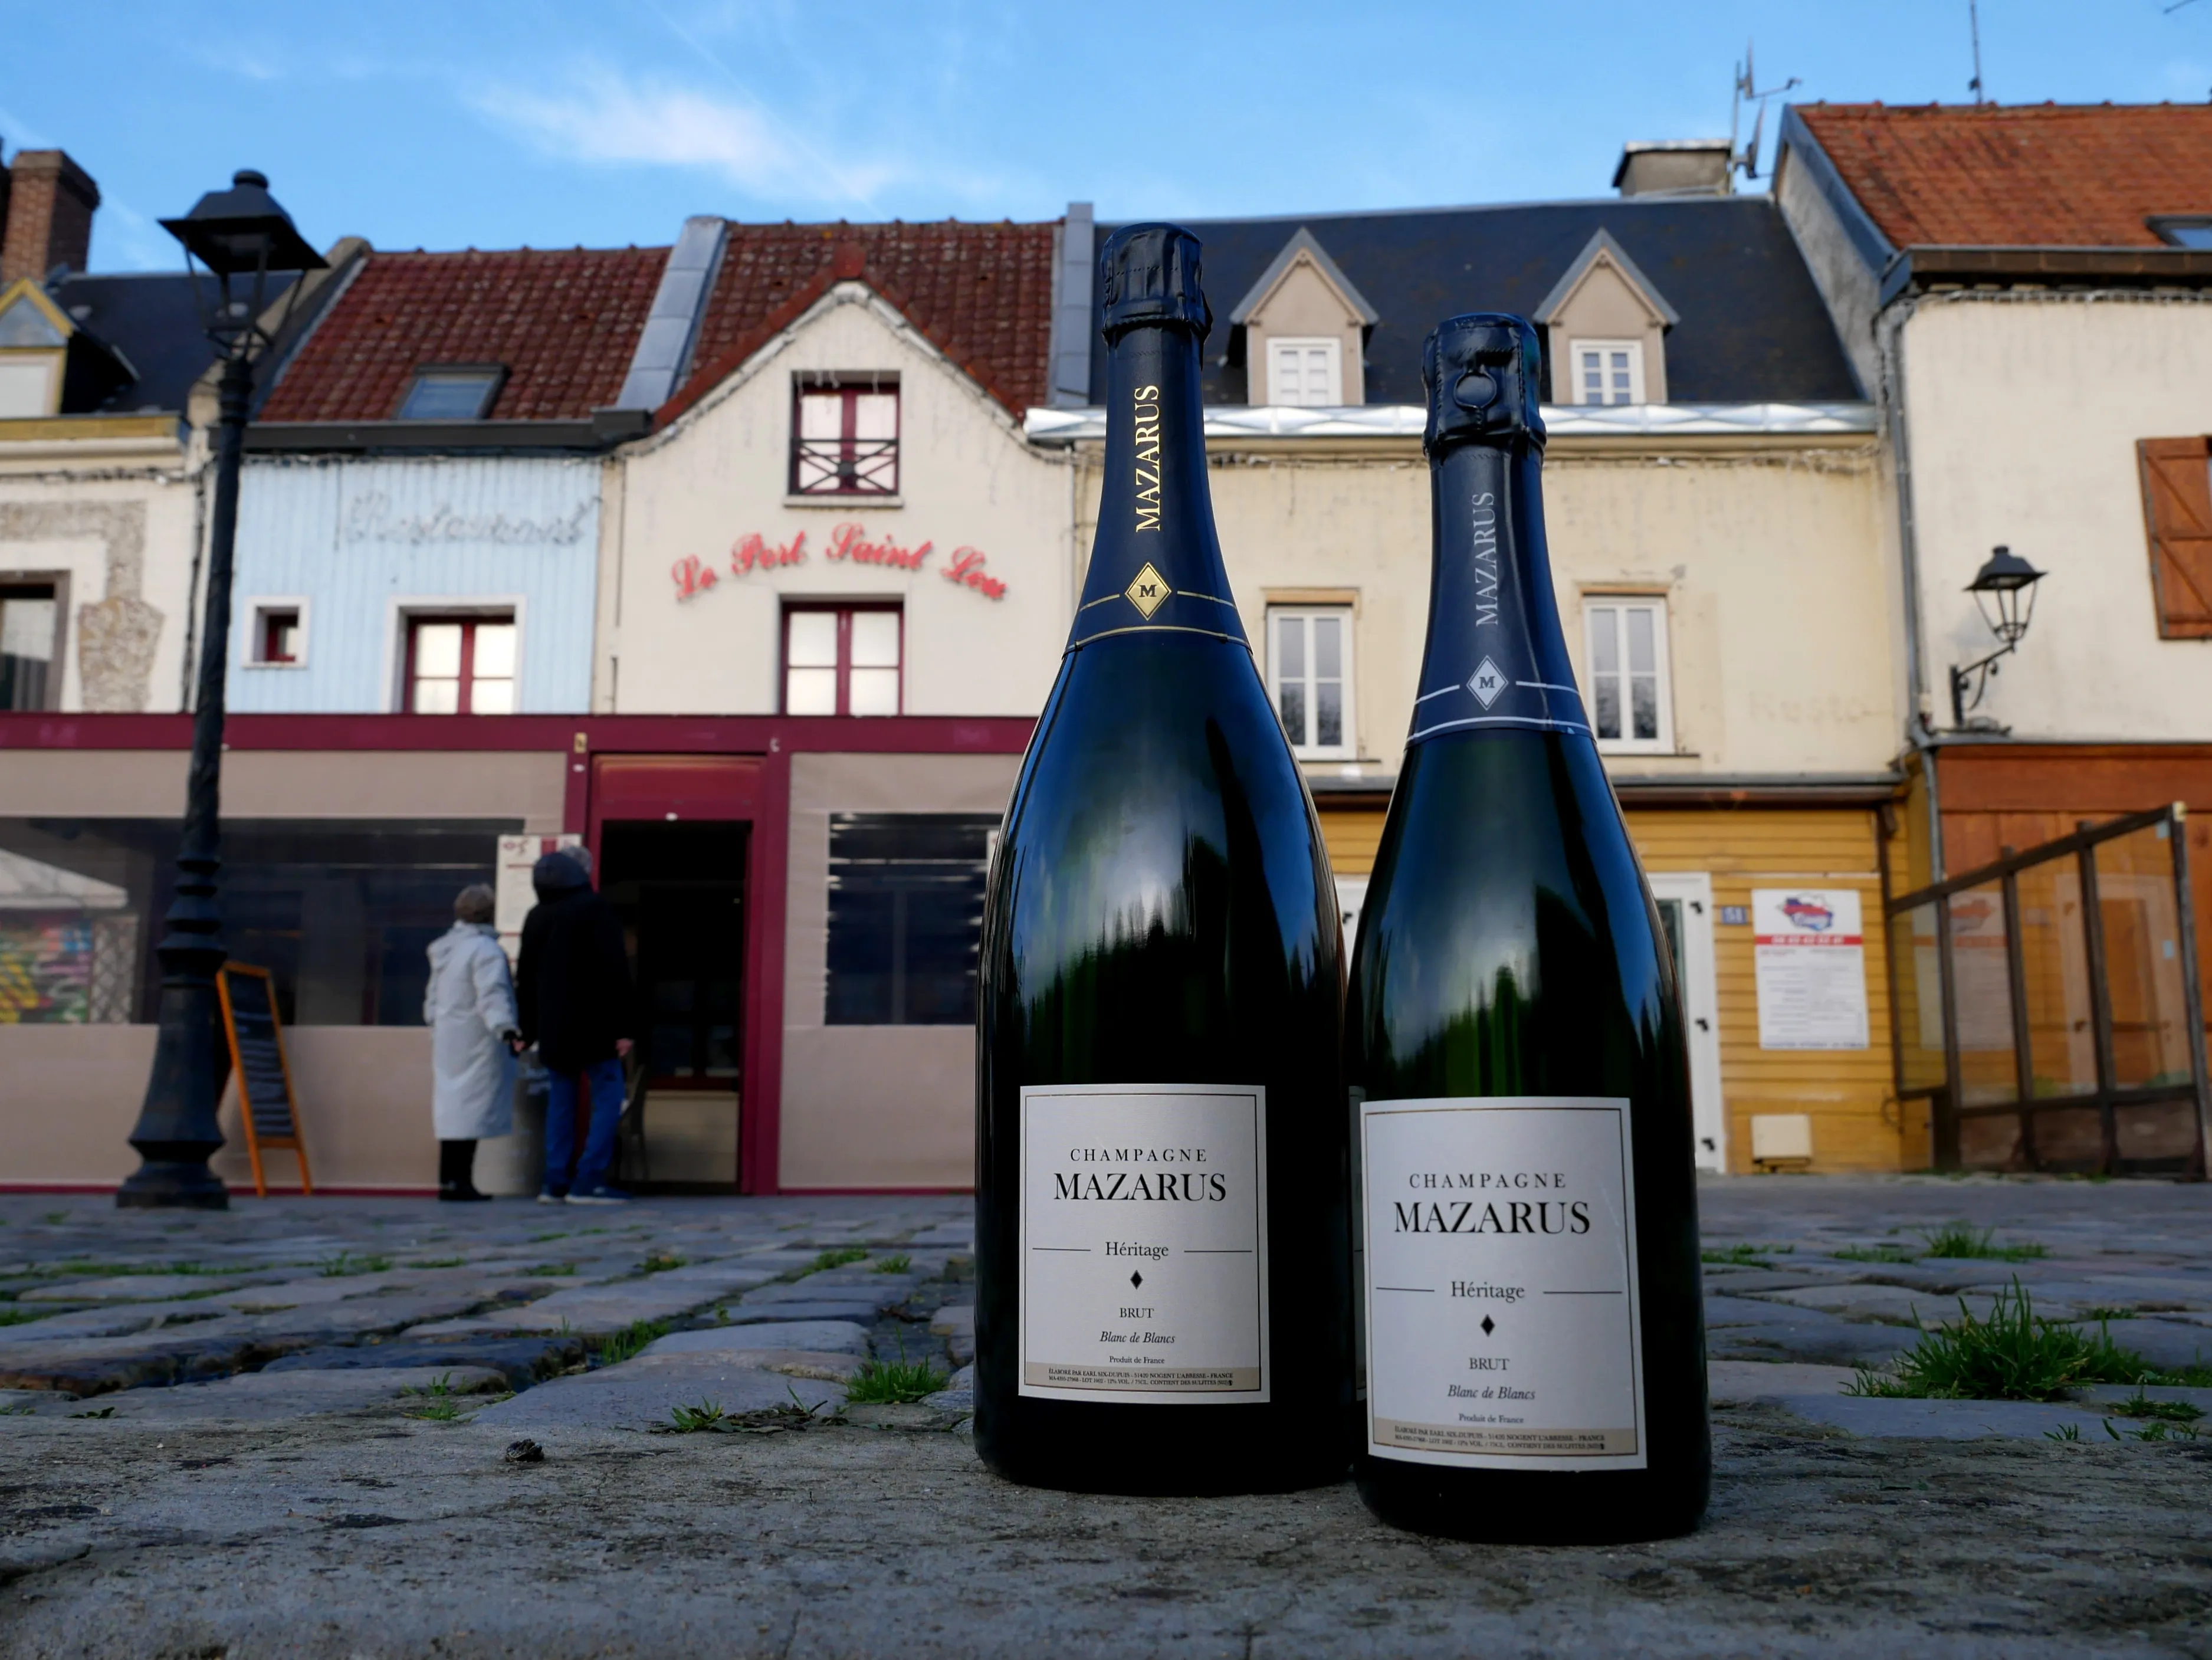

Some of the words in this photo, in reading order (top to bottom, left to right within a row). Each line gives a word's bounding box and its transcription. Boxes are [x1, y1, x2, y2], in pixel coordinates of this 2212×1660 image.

[1134, 385, 1160, 532] MAZARUS
[672, 555, 718, 601] Le
[731, 530, 807, 575] Port
[826, 523, 933, 571] Saint
[1472, 491, 1498, 626] MAZARUS
[1139, 584, 1157, 598] M
[1479, 676, 1495, 689] M
[1070, 1149, 1207, 1162] CHAMPAGNE
[1054, 1173, 1226, 1201] MAZARUS
[1409, 1173, 1566, 1189] CHAMPAGNE
[1394, 1201, 1590, 1234] MAZARUS
[1105, 1241, 1169, 1261] Héritage
[1450, 1281, 1525, 1303] Héritage
[1119, 1307, 1155, 1318] BRUT
[1100, 1331, 1127, 1343] Blanc
[1130, 1332, 1141, 1343] de
[1142, 1332, 1176, 1344] Blancs
[1109, 1356, 1133, 1364] Produit
[1143, 1356, 1165, 1364] France
[1469, 1357, 1510, 1370] BRUT
[1448, 1385, 1479, 1398] Blanc
[1481, 1386, 1494, 1399] de
[1498, 1386, 1536, 1400] Blancs
[1459, 1413, 1486, 1423] Produit
[1487, 1414, 1496, 1423] de
[1498, 1415, 1524, 1424] France
